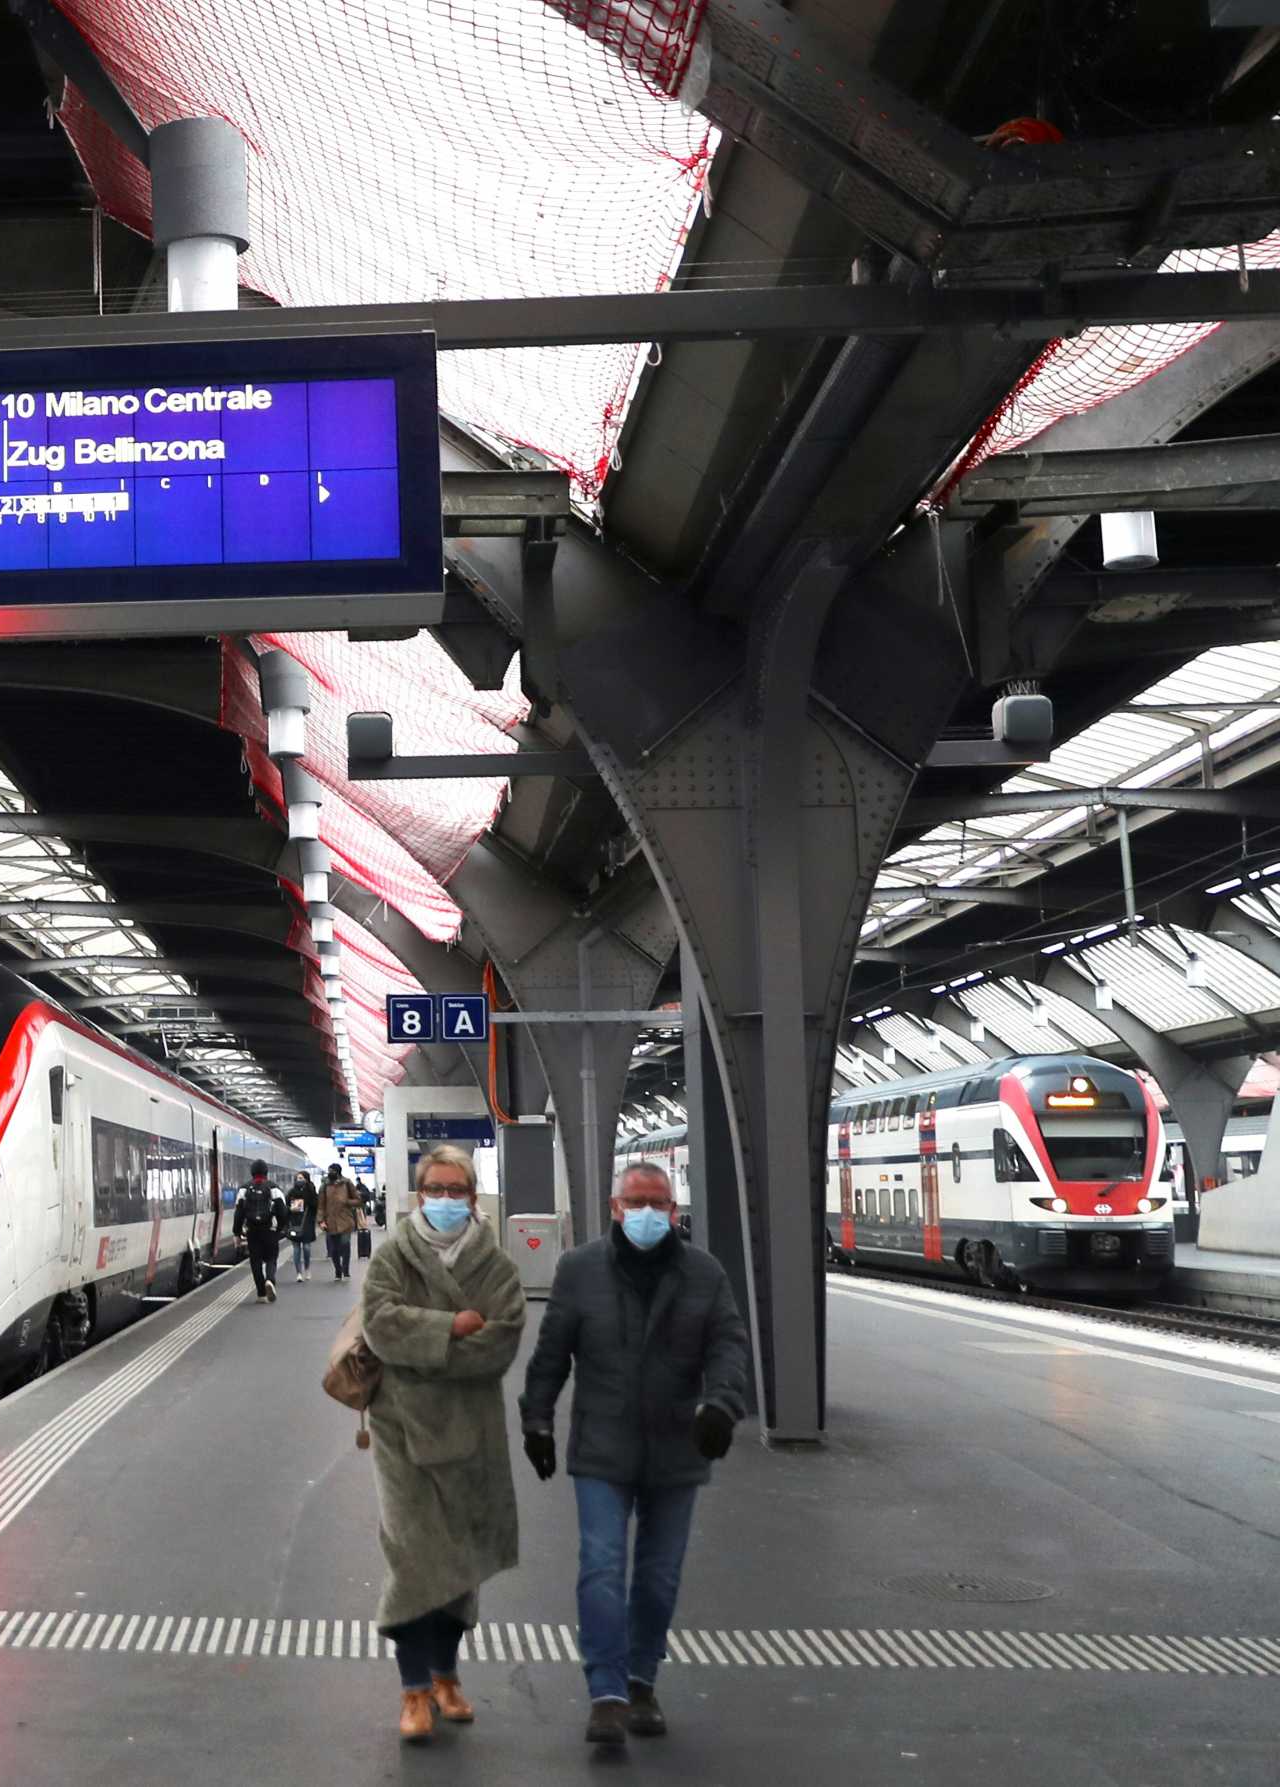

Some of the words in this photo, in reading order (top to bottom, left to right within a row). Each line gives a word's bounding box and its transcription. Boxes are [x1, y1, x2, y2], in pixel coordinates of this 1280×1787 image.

[46, 391, 140, 418] Milano
[144, 385, 272, 413] Centrale
[7, 441, 65, 471] Zug
[75, 437, 225, 464] Bellinzona
[160, 478, 170, 489] C
[260, 474, 269, 486] D
[1, 498, 14, 513] 2
[402, 1010, 422, 1035] 8
[454, 1010, 475, 1034] A
